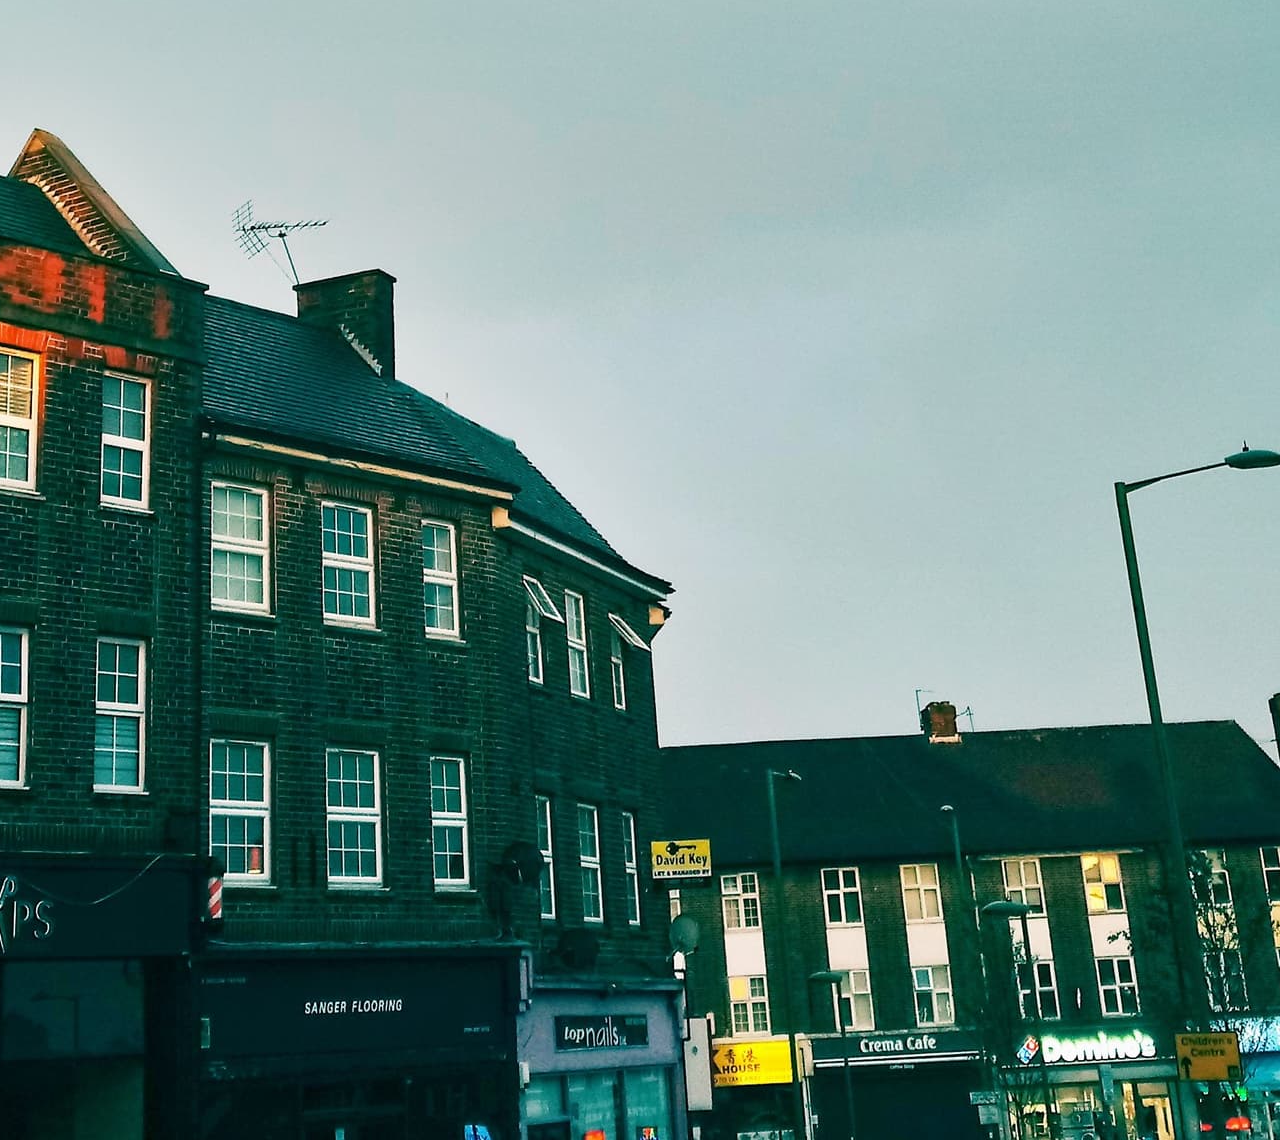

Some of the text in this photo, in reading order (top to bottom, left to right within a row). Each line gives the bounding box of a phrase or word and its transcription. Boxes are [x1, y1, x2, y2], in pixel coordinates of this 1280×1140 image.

[655, 852, 708, 867] David Key
[304, 998, 403, 1015] SANGER FLOORING
[860, 1034, 937, 1053] Crema Cafe
[1041, 1029, 1156, 1063] Domino's
[1190, 1048, 1226, 1057] Centre
[722, 1063, 761, 1074] HOUSE
